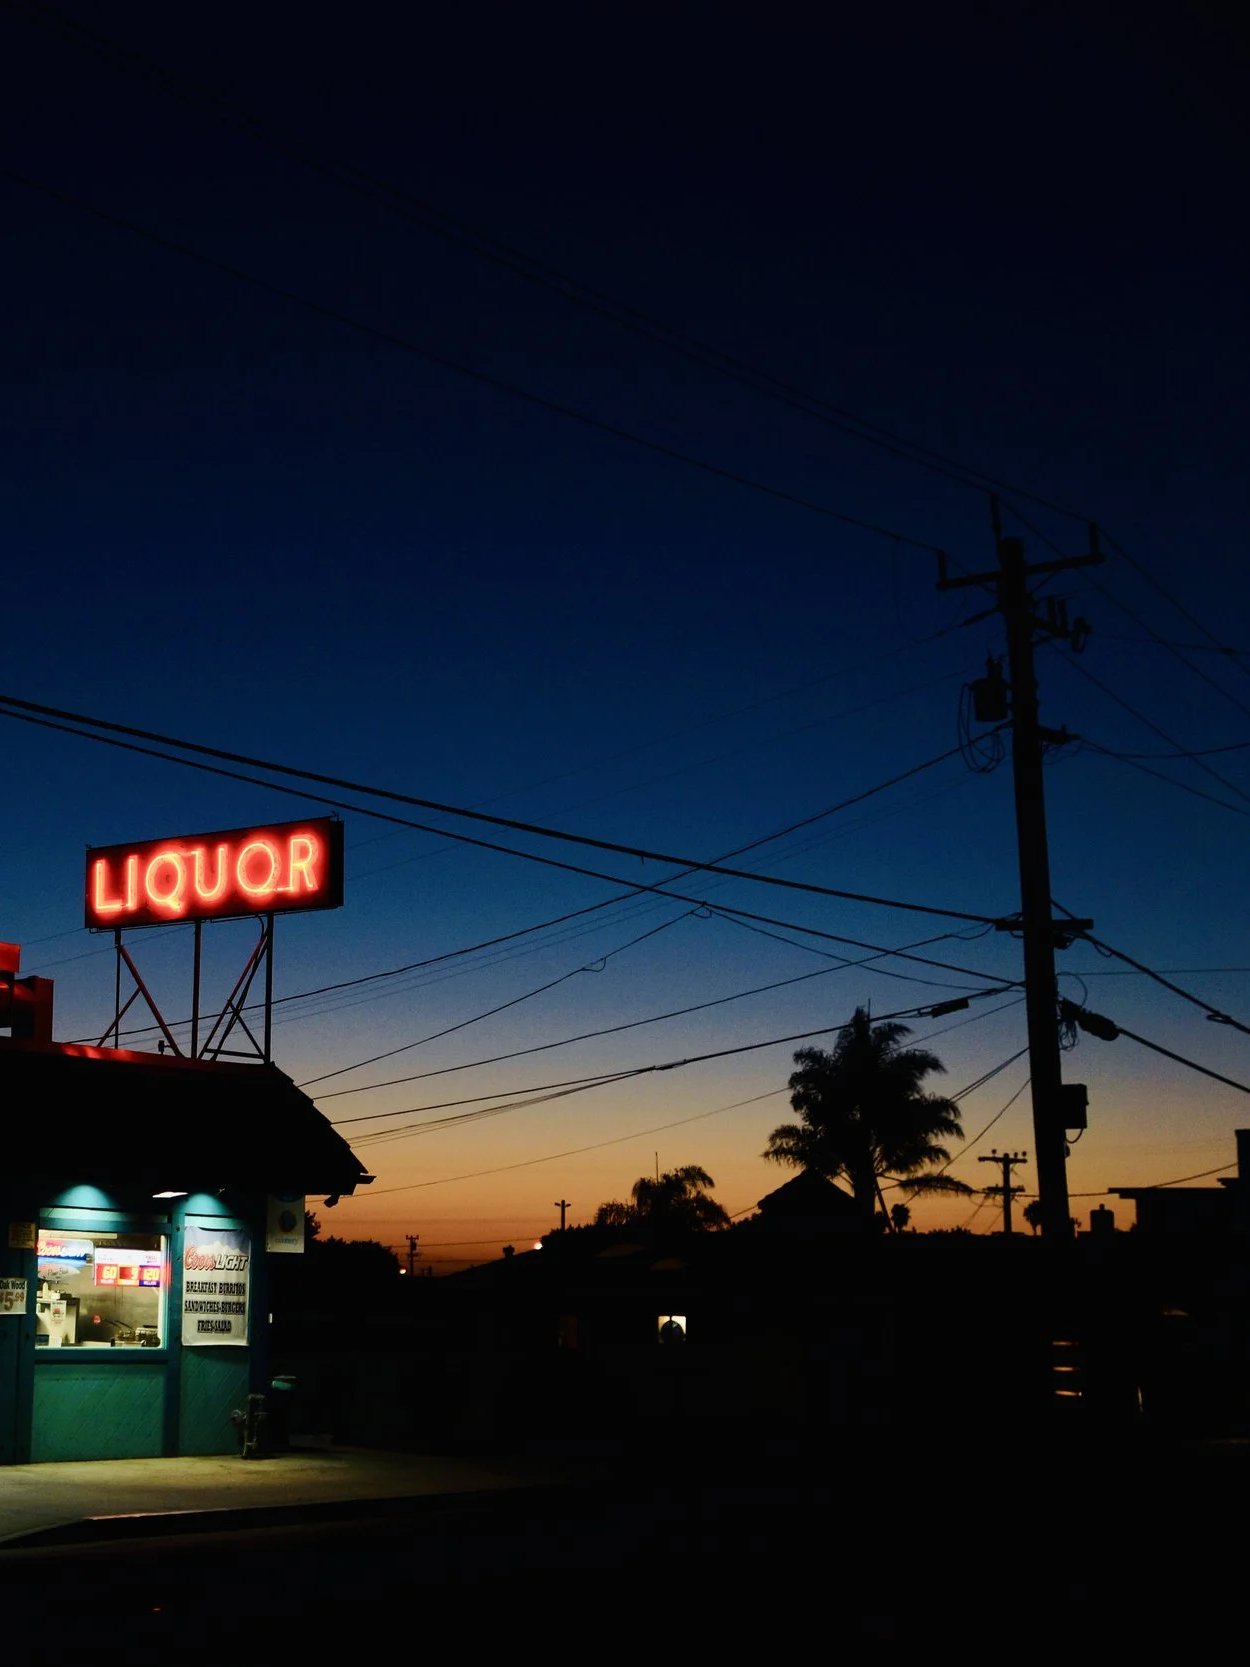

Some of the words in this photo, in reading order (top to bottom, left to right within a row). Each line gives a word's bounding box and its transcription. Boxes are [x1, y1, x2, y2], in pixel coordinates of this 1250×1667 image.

[93, 834, 319, 914] LIQUOR
[184, 1245, 215, 1271] Coors
[215, 1254, 249, 1271] LIGHT
[0, 1280, 10, 1290] Oak
[11, 1280, 26, 1290] Wood
[185, 1281, 217, 1295] BREAKFAST
[218, 1282, 246, 1297] BURRITOS
